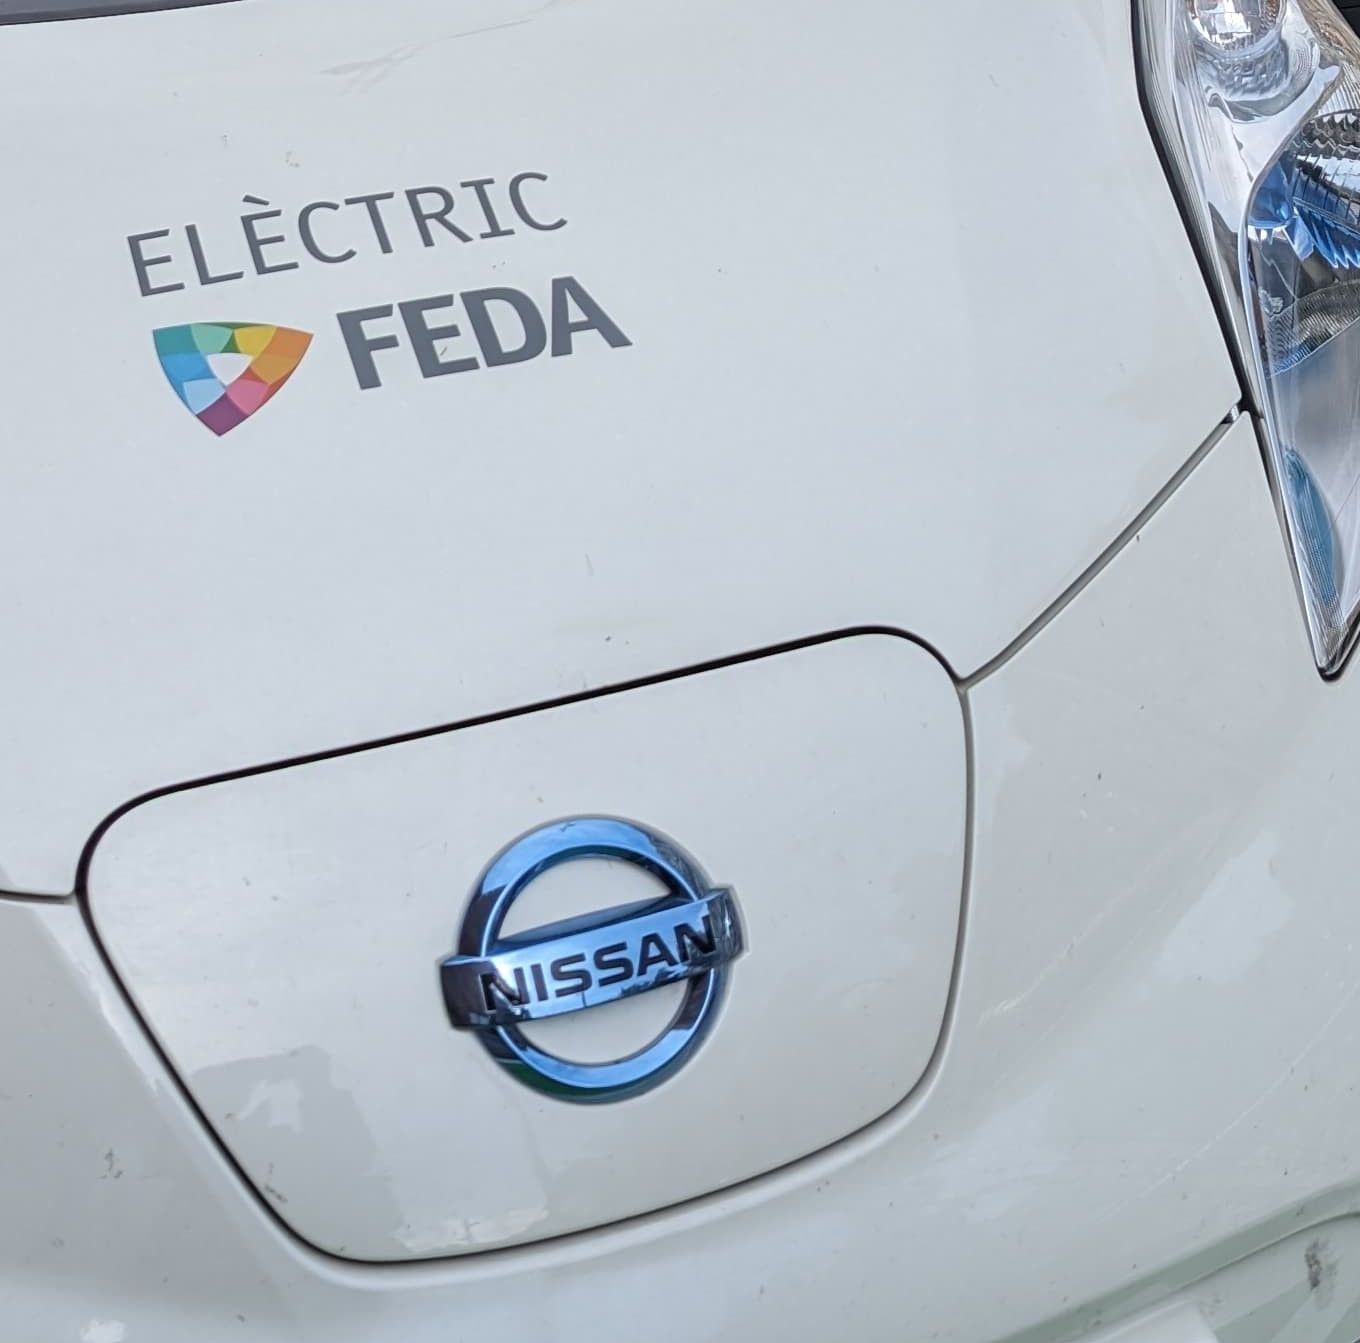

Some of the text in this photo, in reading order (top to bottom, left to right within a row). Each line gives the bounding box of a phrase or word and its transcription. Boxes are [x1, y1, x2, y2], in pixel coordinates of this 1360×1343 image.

[127, 171, 568, 297] ELÈCTRIC
[336, 276, 633, 390] FEDA
[478, 914, 717, 1011] NISSAN
